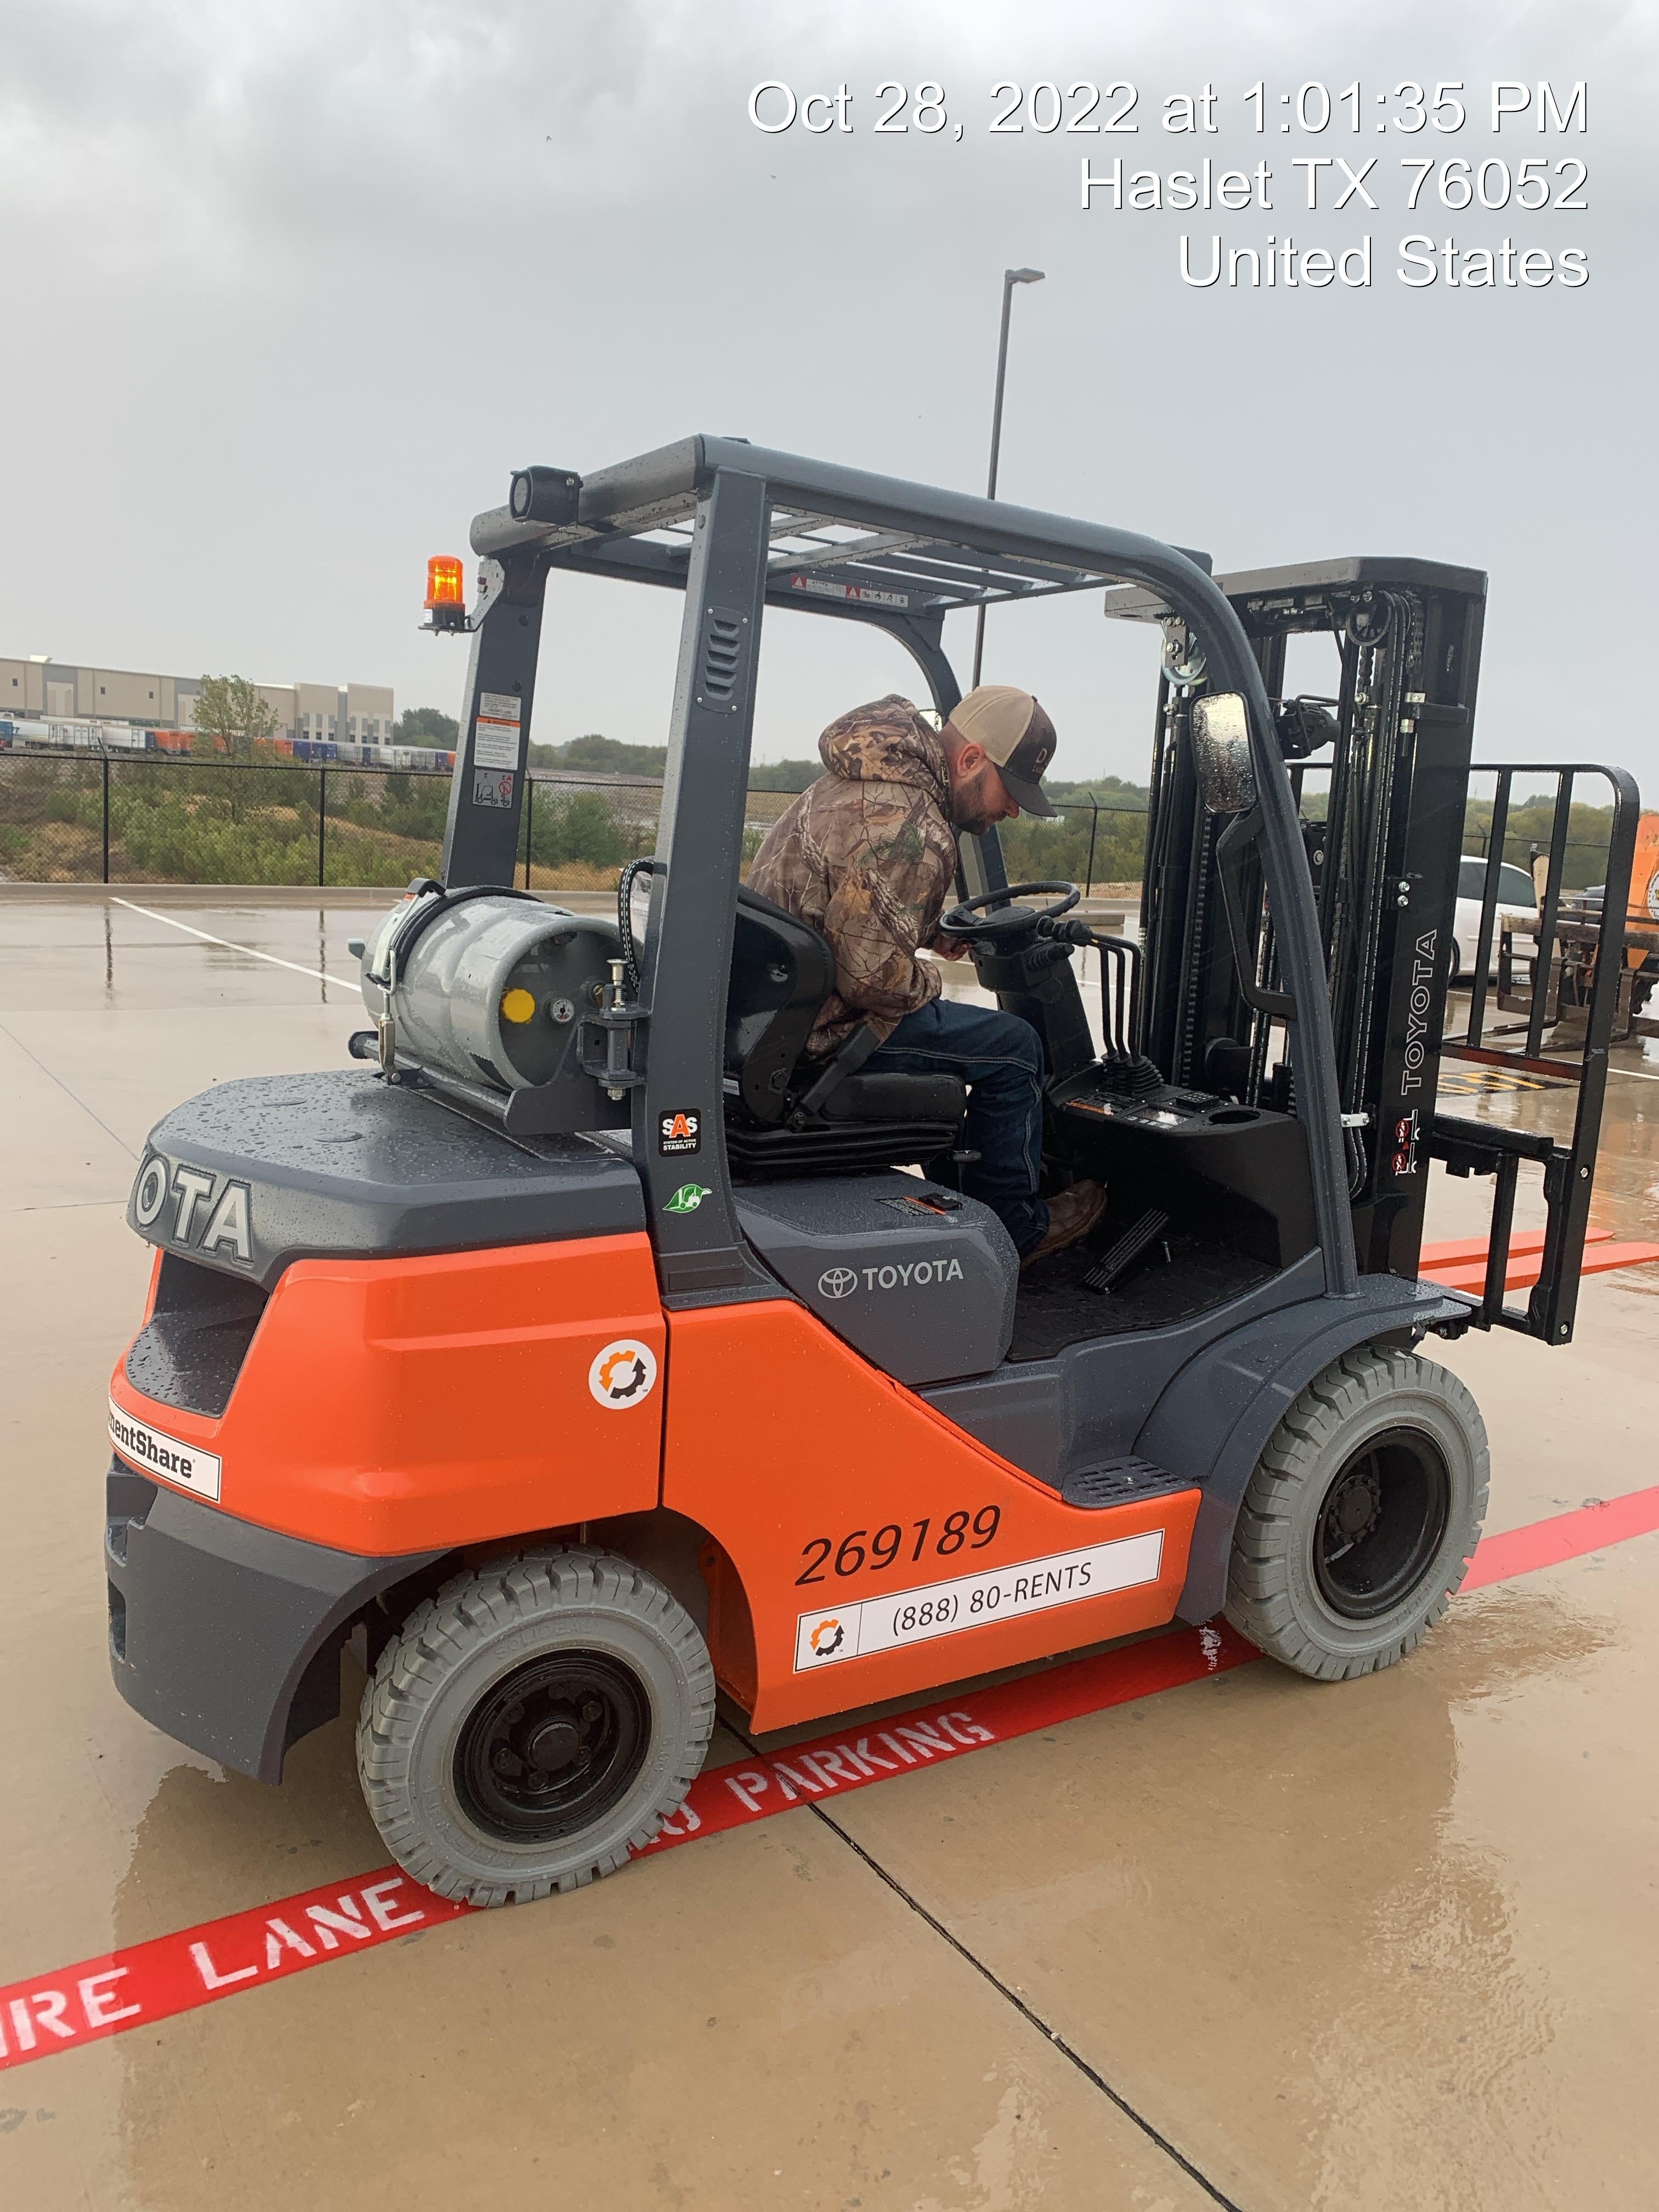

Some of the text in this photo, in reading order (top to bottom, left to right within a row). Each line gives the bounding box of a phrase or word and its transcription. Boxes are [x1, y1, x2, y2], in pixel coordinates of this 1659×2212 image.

[1401, 928, 1438, 1096] TOYOTA
[662, 1114, 698, 1138] SAS
[663, 1142, 697, 1151] STABILITY
[862, 1258, 964, 1290] TOYOTA
[794, 1504, 1001, 1587] 269189
[892, 1561, 1092, 1637] (888) 80-RENTS
[0, 1966, 143, 2059] IRE
[189, 1877, 425, 1991] LANE
[724, 1711, 995, 1812] PARKING
